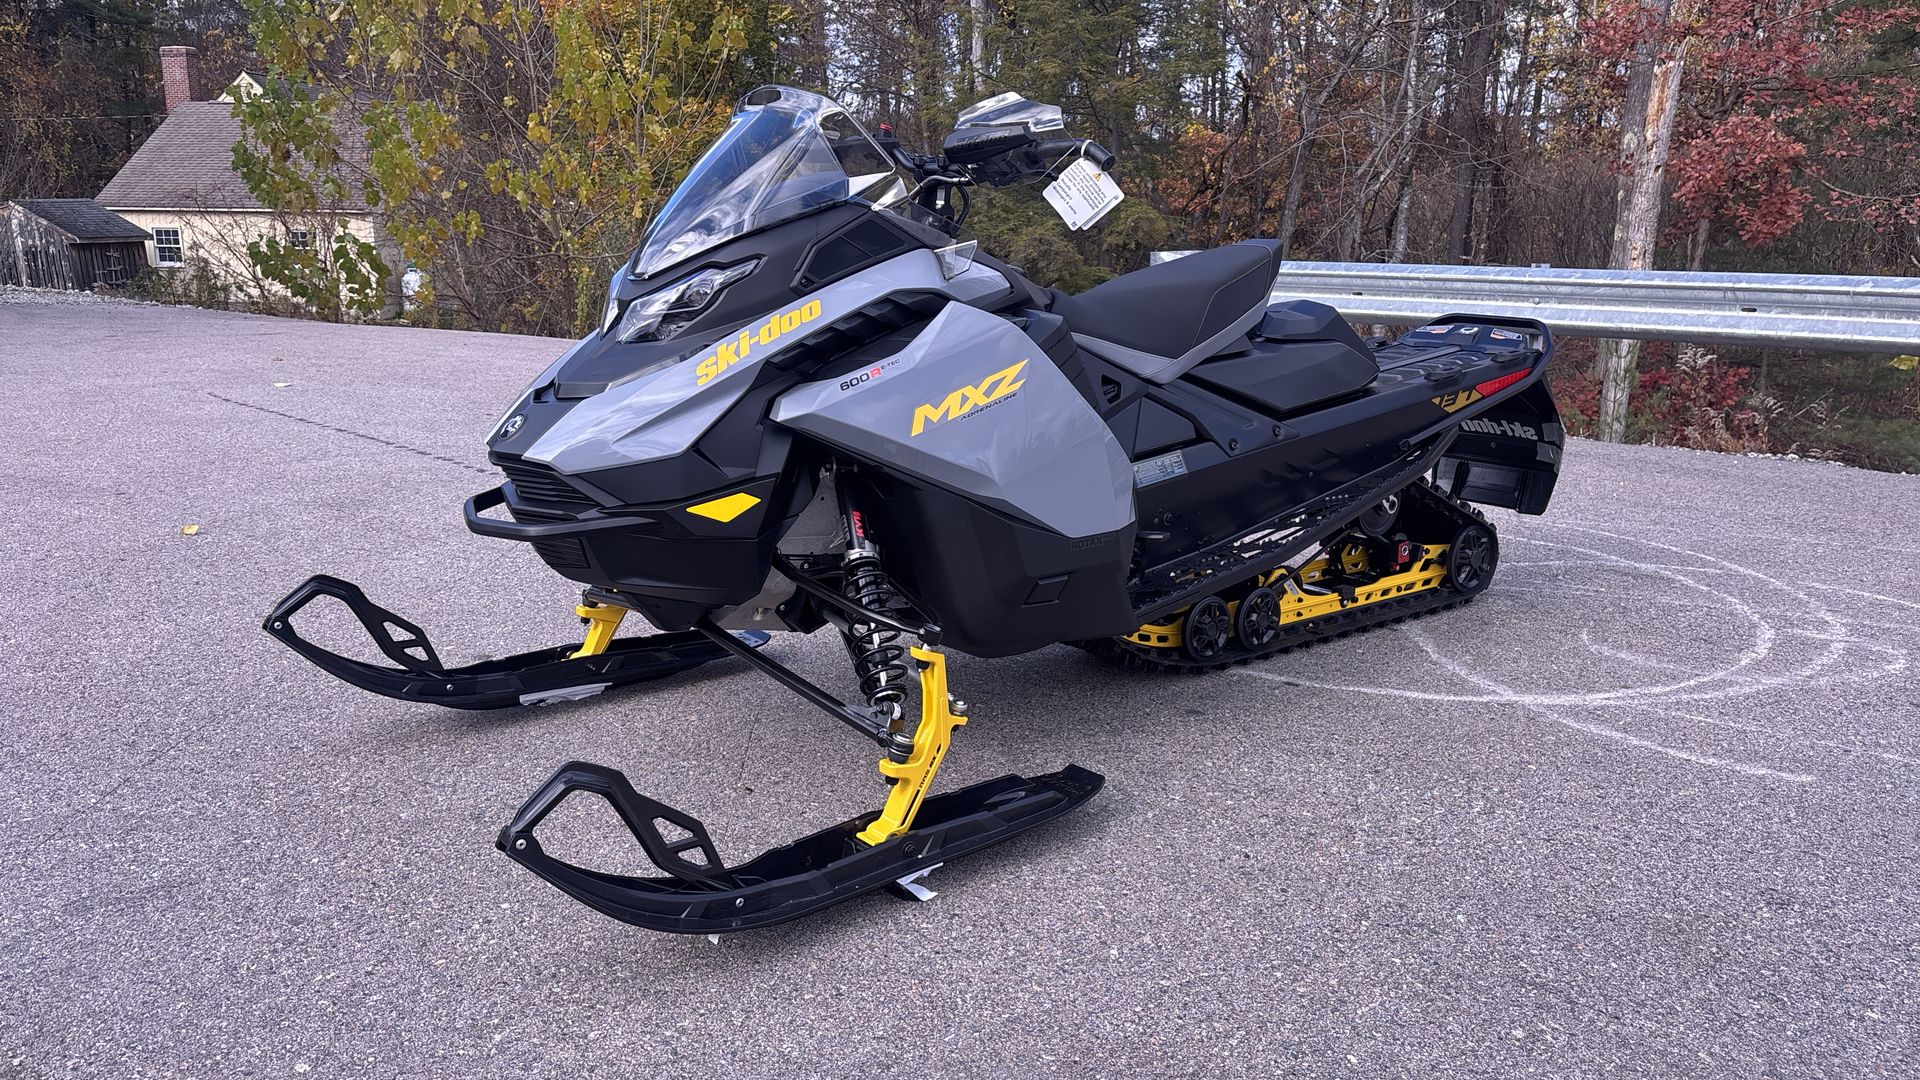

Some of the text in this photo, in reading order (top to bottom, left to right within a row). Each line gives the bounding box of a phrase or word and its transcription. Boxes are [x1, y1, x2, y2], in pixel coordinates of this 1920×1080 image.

[695, 299, 823, 387] ski-doo
[840, 368, 881, 391] 600R
[911, 359, 1029, 437] MXZ
[960, 392, 1018, 421] ADRENALINE
[1071, 536, 1104, 550] ROTAX
